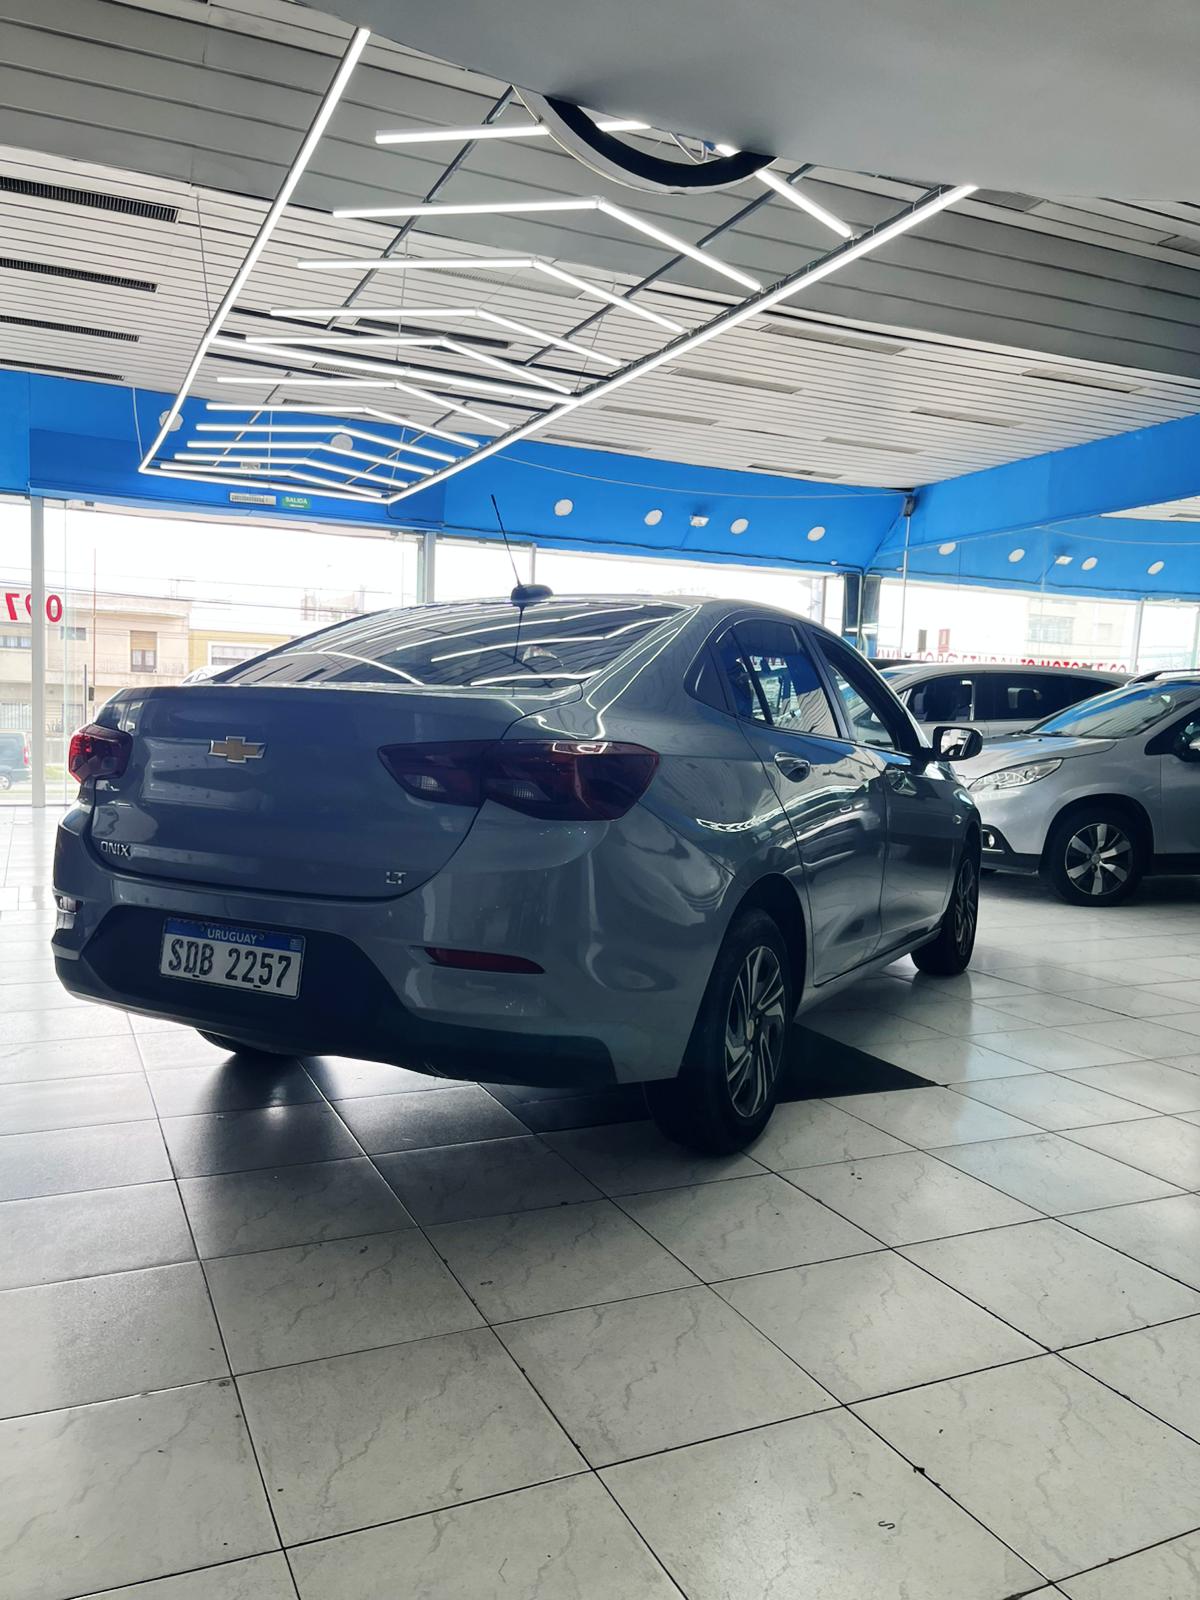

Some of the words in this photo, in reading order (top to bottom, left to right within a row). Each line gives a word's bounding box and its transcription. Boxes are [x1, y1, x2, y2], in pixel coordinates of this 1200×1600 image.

[285, 496, 308, 505] SALIDA
[101, 841, 129, 857] ONIX
[386, 871, 407, 884] LT
[207, 928, 258, 945] URUGUAY
[168, 938, 215, 976] SDB
[225, 947, 292, 988] 2257
